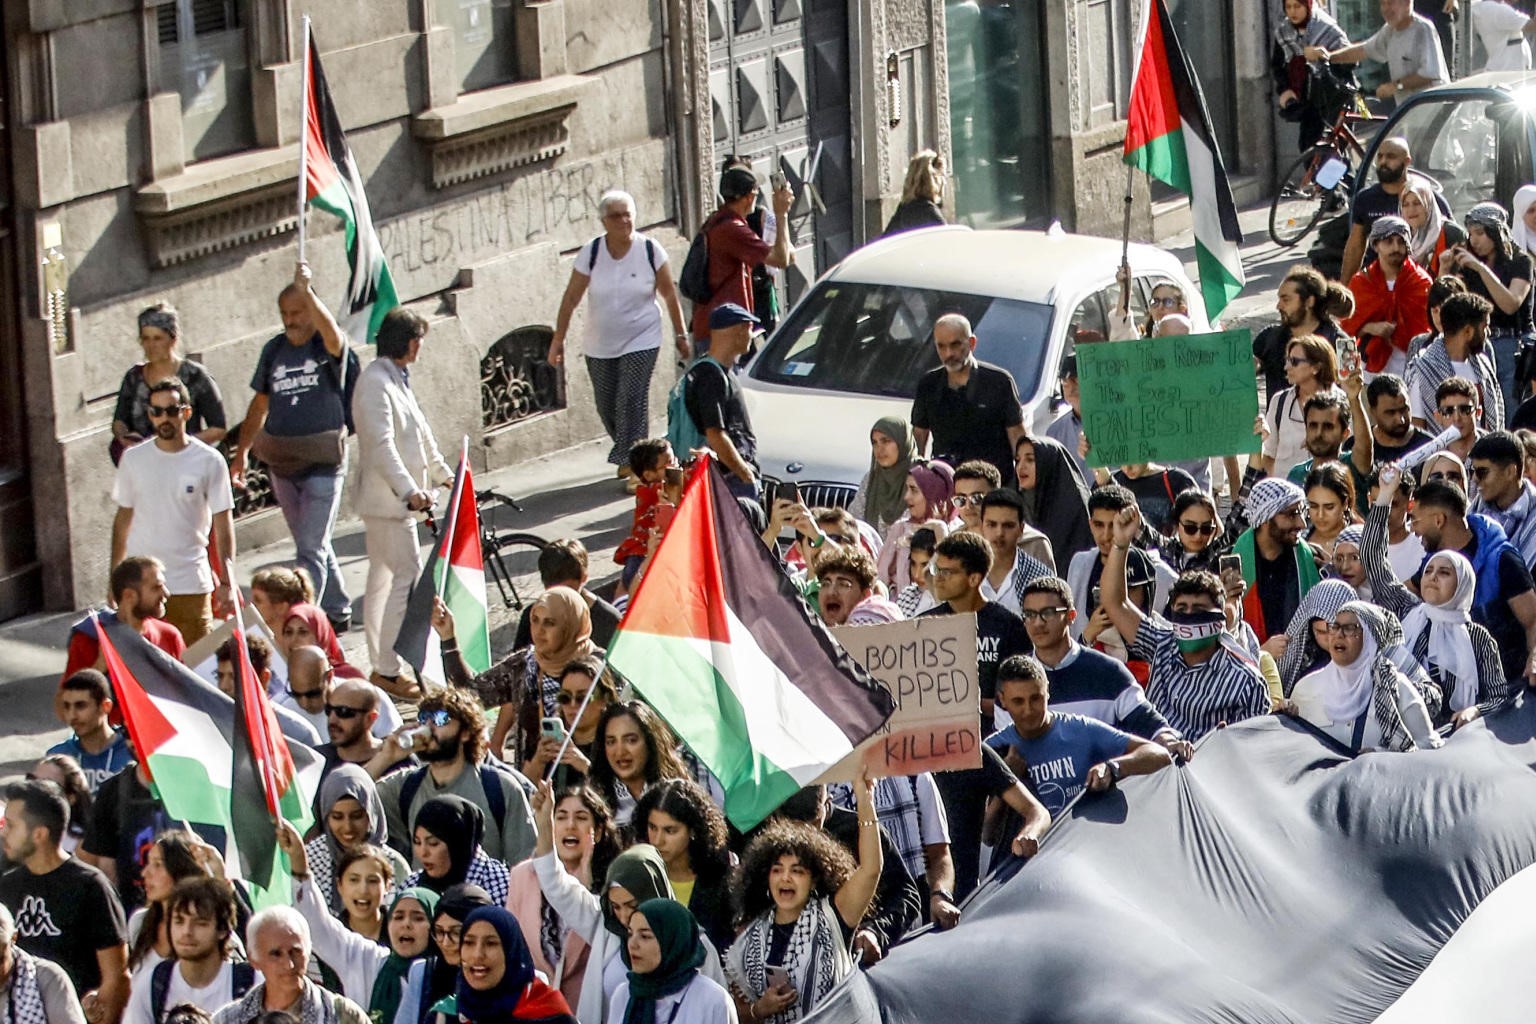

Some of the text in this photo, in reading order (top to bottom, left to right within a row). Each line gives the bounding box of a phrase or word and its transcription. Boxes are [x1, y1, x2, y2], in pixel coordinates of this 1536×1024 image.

[377, 187, 514, 273] PALESTINA
[865, 637, 957, 672] BOMBS
[884, 729, 976, 766] KILLED
